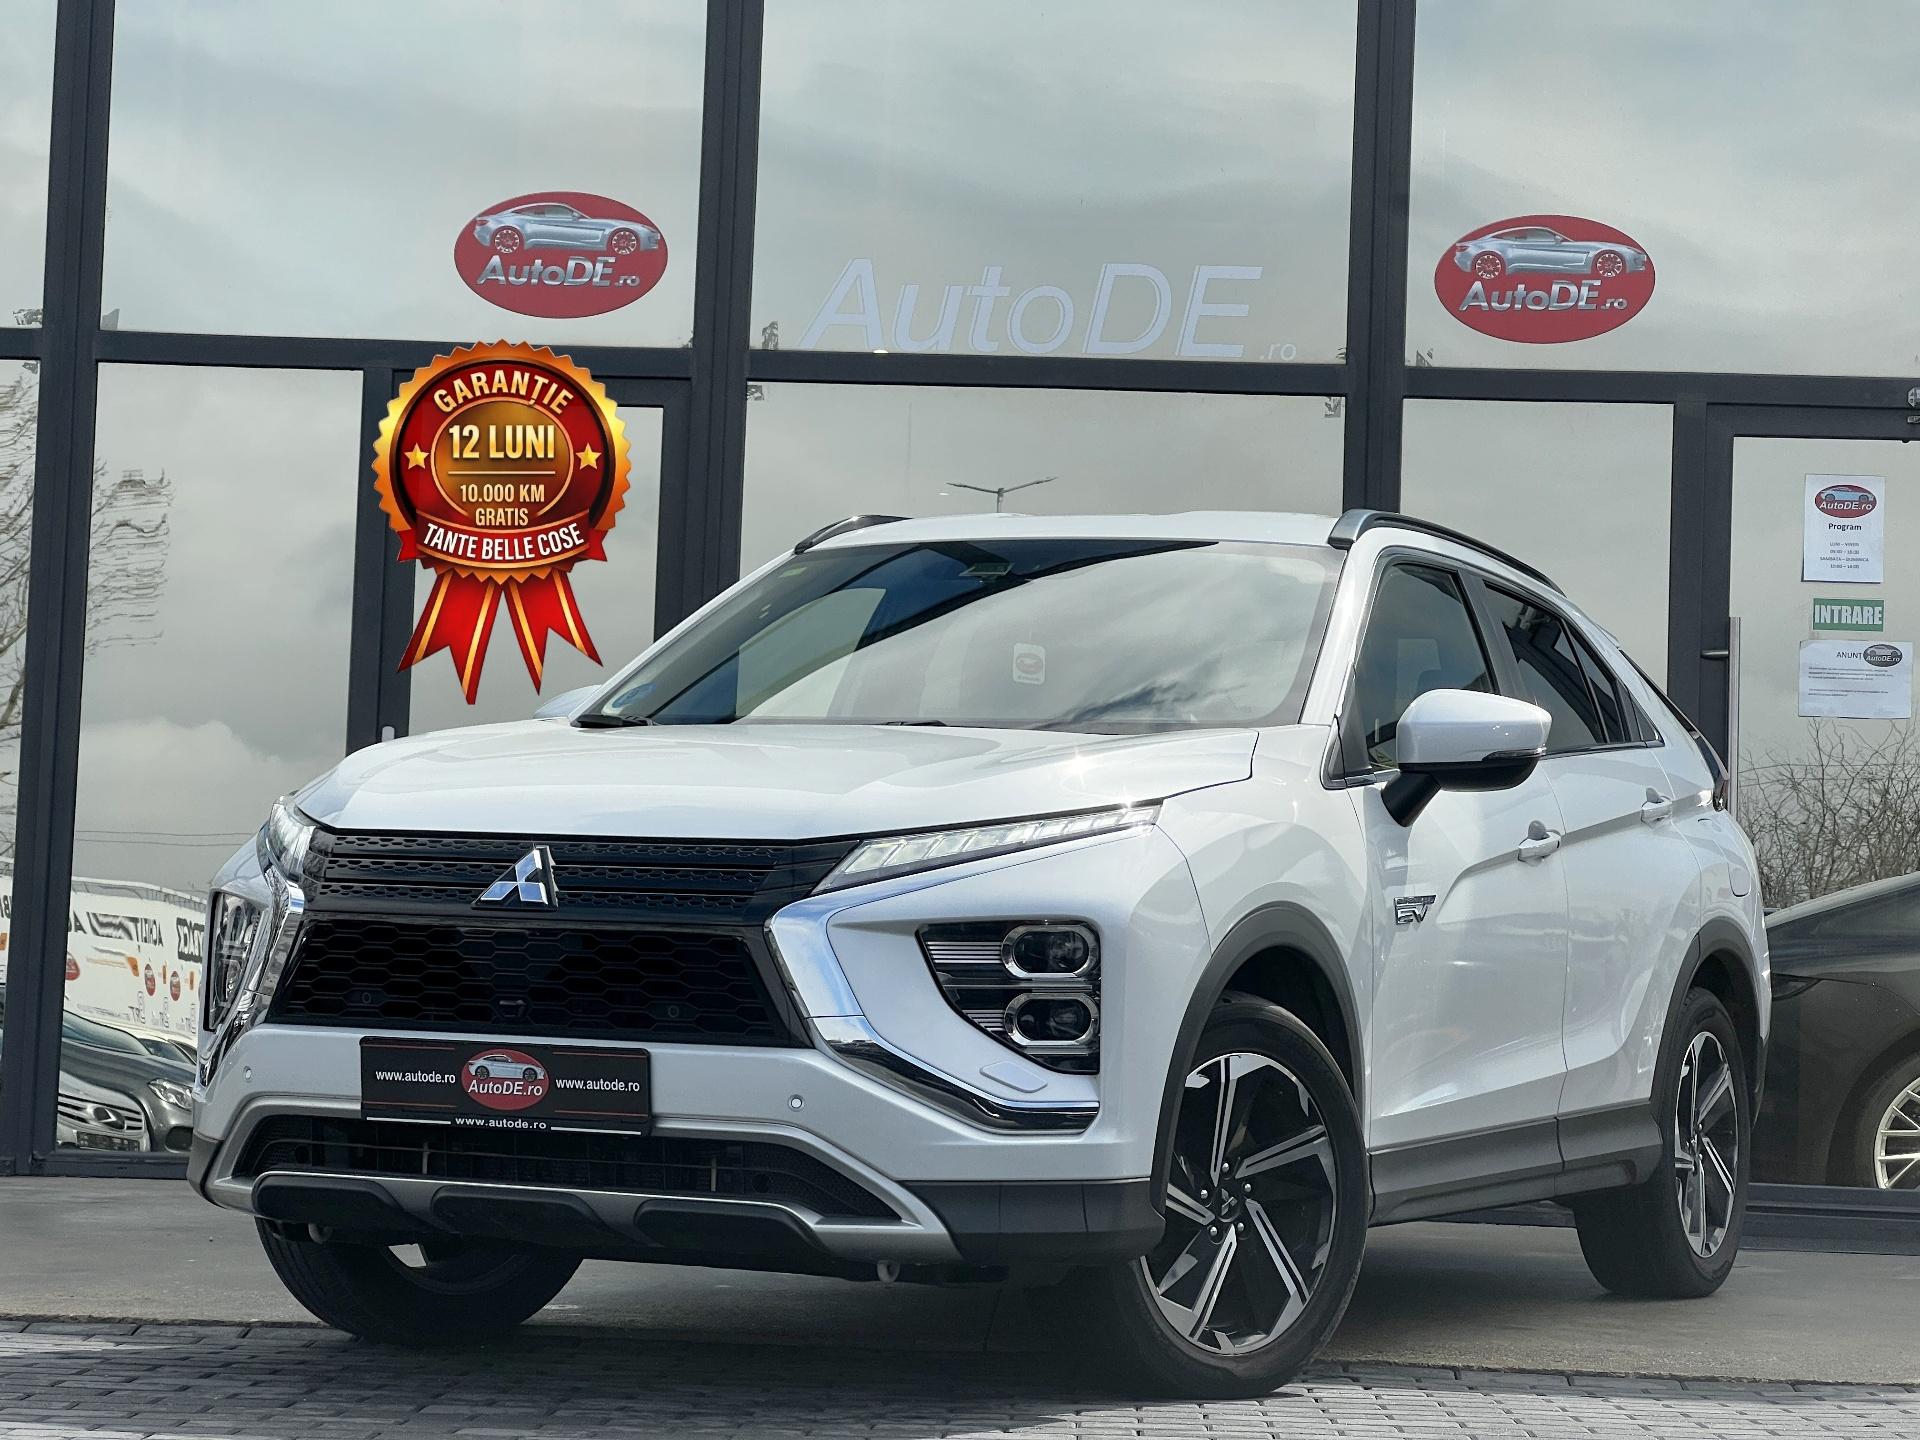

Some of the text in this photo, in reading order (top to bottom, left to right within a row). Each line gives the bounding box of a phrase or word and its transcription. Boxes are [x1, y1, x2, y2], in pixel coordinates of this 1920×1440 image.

[1819, 501, 1873, 511] AutoDE.ro
[1828, 523, 1862, 531] Program
[1814, 604, 1883, 624] INTRARE
[375, 1070, 456, 1084] www.autode.ro
[555, 1077, 640, 1092] www.autode.ro
[467, 1078, 543, 1097] AutoDE.ro
[454, 1115, 547, 1130] www.autode.ro
